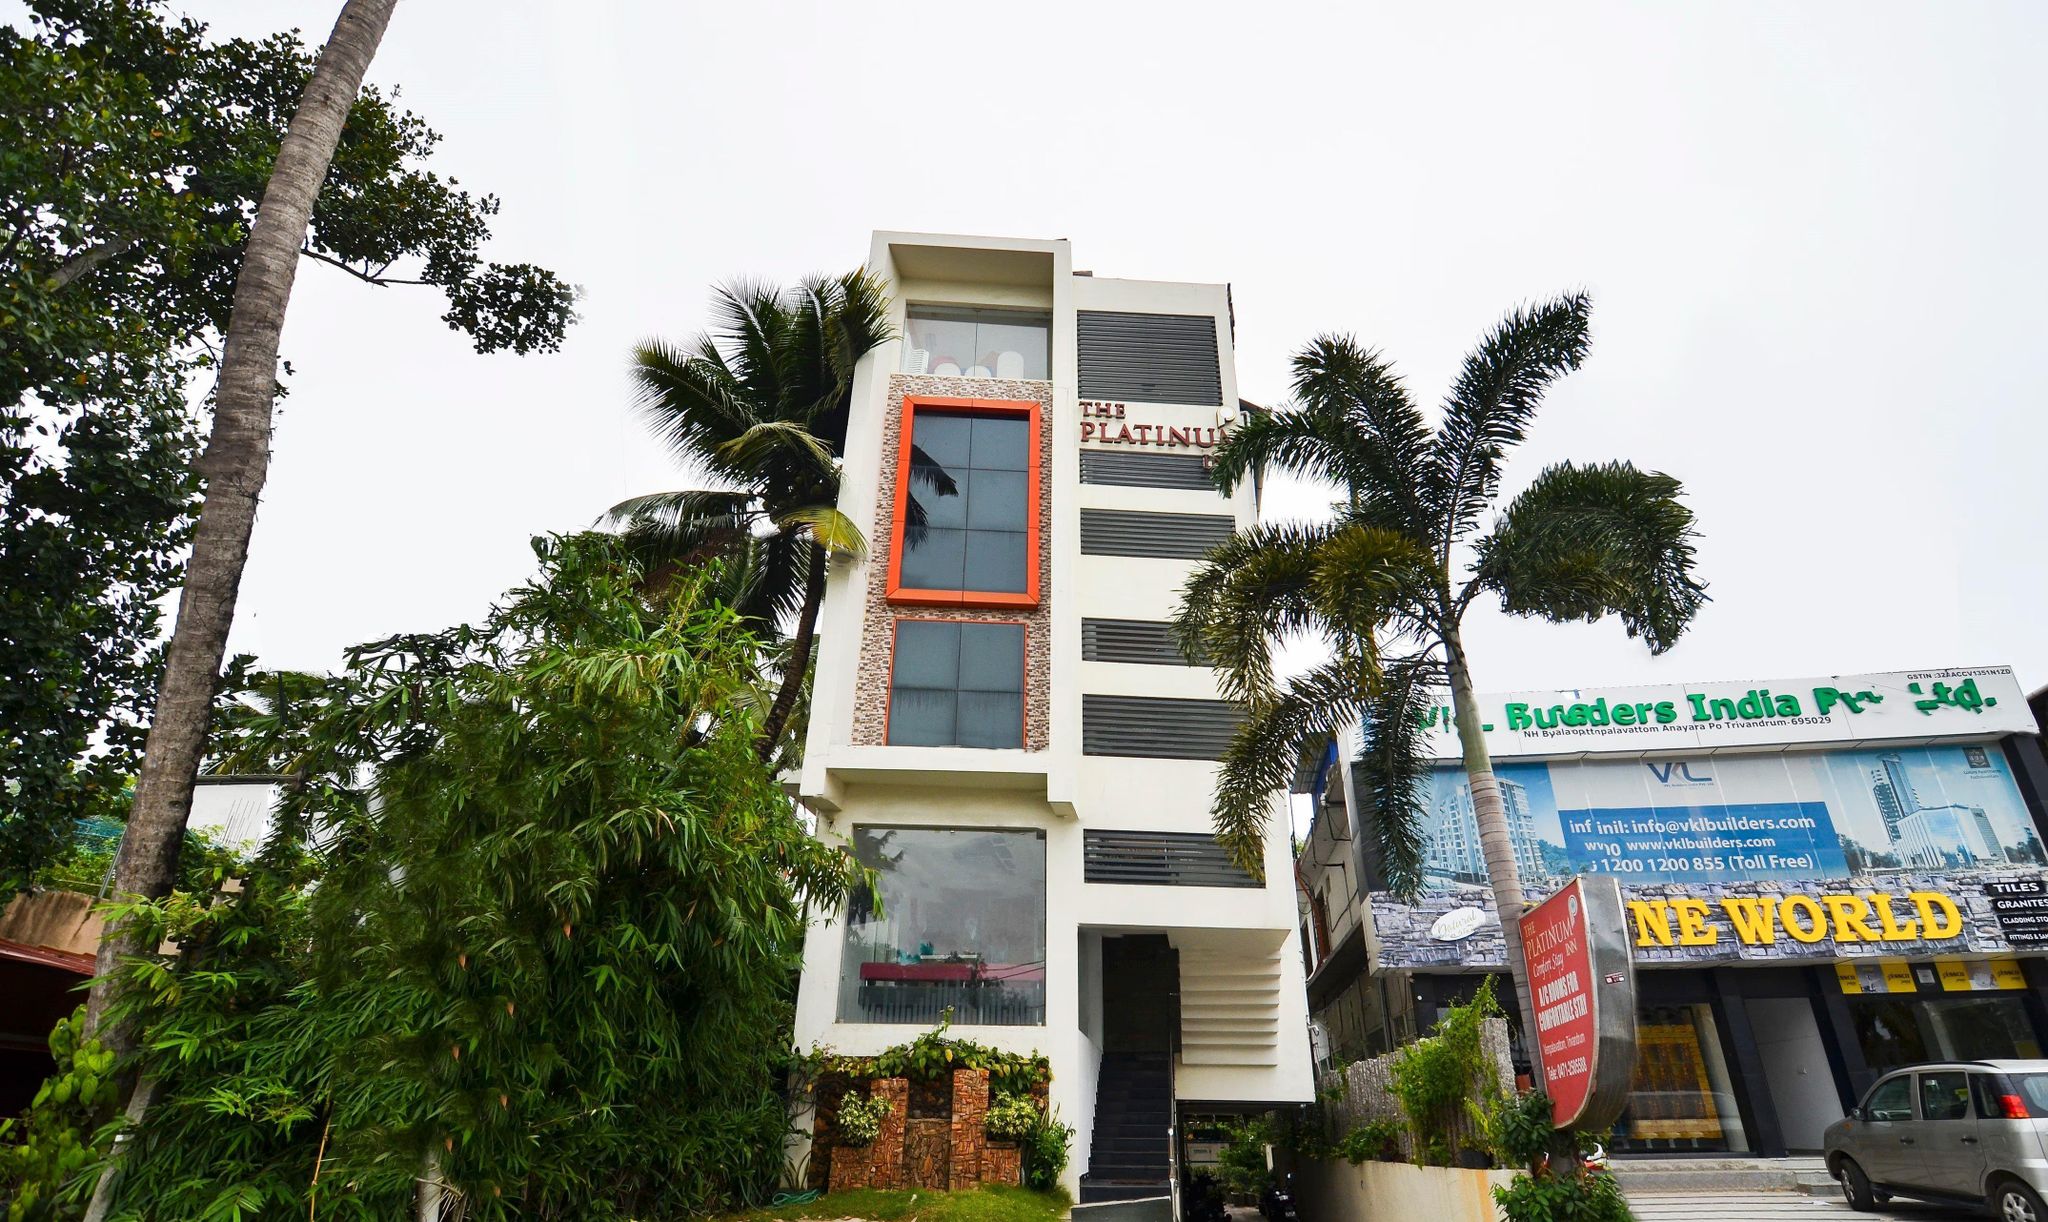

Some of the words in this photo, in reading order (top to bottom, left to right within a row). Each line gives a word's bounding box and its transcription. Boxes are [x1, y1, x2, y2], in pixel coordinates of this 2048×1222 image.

[1079, 401, 1126, 419] THE
[1687, 688, 1802, 722] India
[1523, 730, 1539, 738] NH
[1662, 723, 1705, 733] Anayara
[1708, 722, 1722, 730] Po
[1632, 817, 1816, 833] info@vklbuilders.com
[1626, 837, 1776, 851] www.vklbuilders.com
[1601, 859, 1644, 872] 1200
[1647, 858, 1690, 872] 1200
[1692, 857, 1725, 871] 855
[1728, 855, 1767, 871] (Toll
[1768, 854, 1814, 870] Free)
[1992, 882, 2040, 893] TILES
[1997, 899, 2048, 909] GRANITES
[1628, 899, 1717, 947] NE
[1720, 892, 1963, 945] WORLD
[1523, 921, 1536, 938] THE
[1526, 917, 1574, 960] PLATINUM
